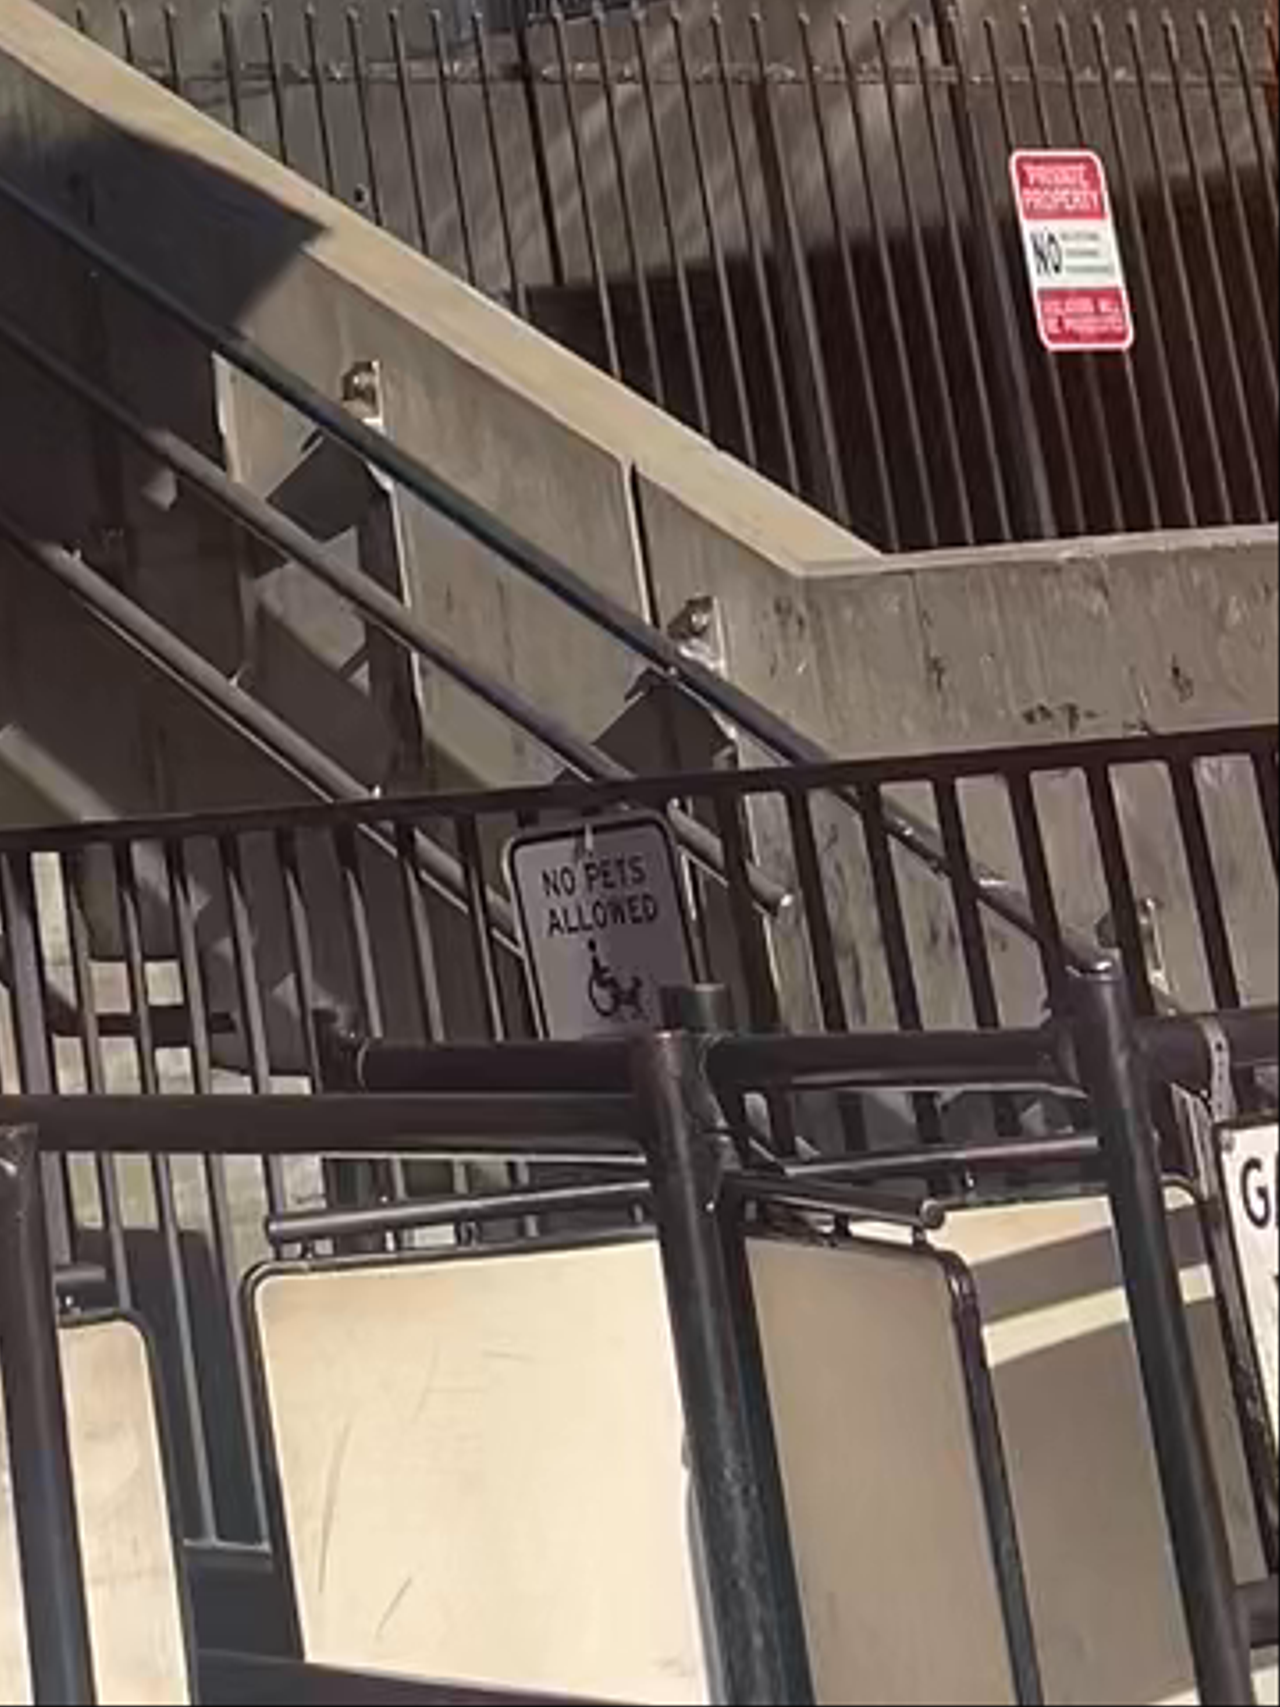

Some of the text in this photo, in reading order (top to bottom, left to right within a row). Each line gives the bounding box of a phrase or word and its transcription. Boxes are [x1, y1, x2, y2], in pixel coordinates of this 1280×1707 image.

[1030, 230, 1063, 276] NO
[542, 856, 647, 898] NO PETS
[548, 894, 658, 936] ALLOWED
